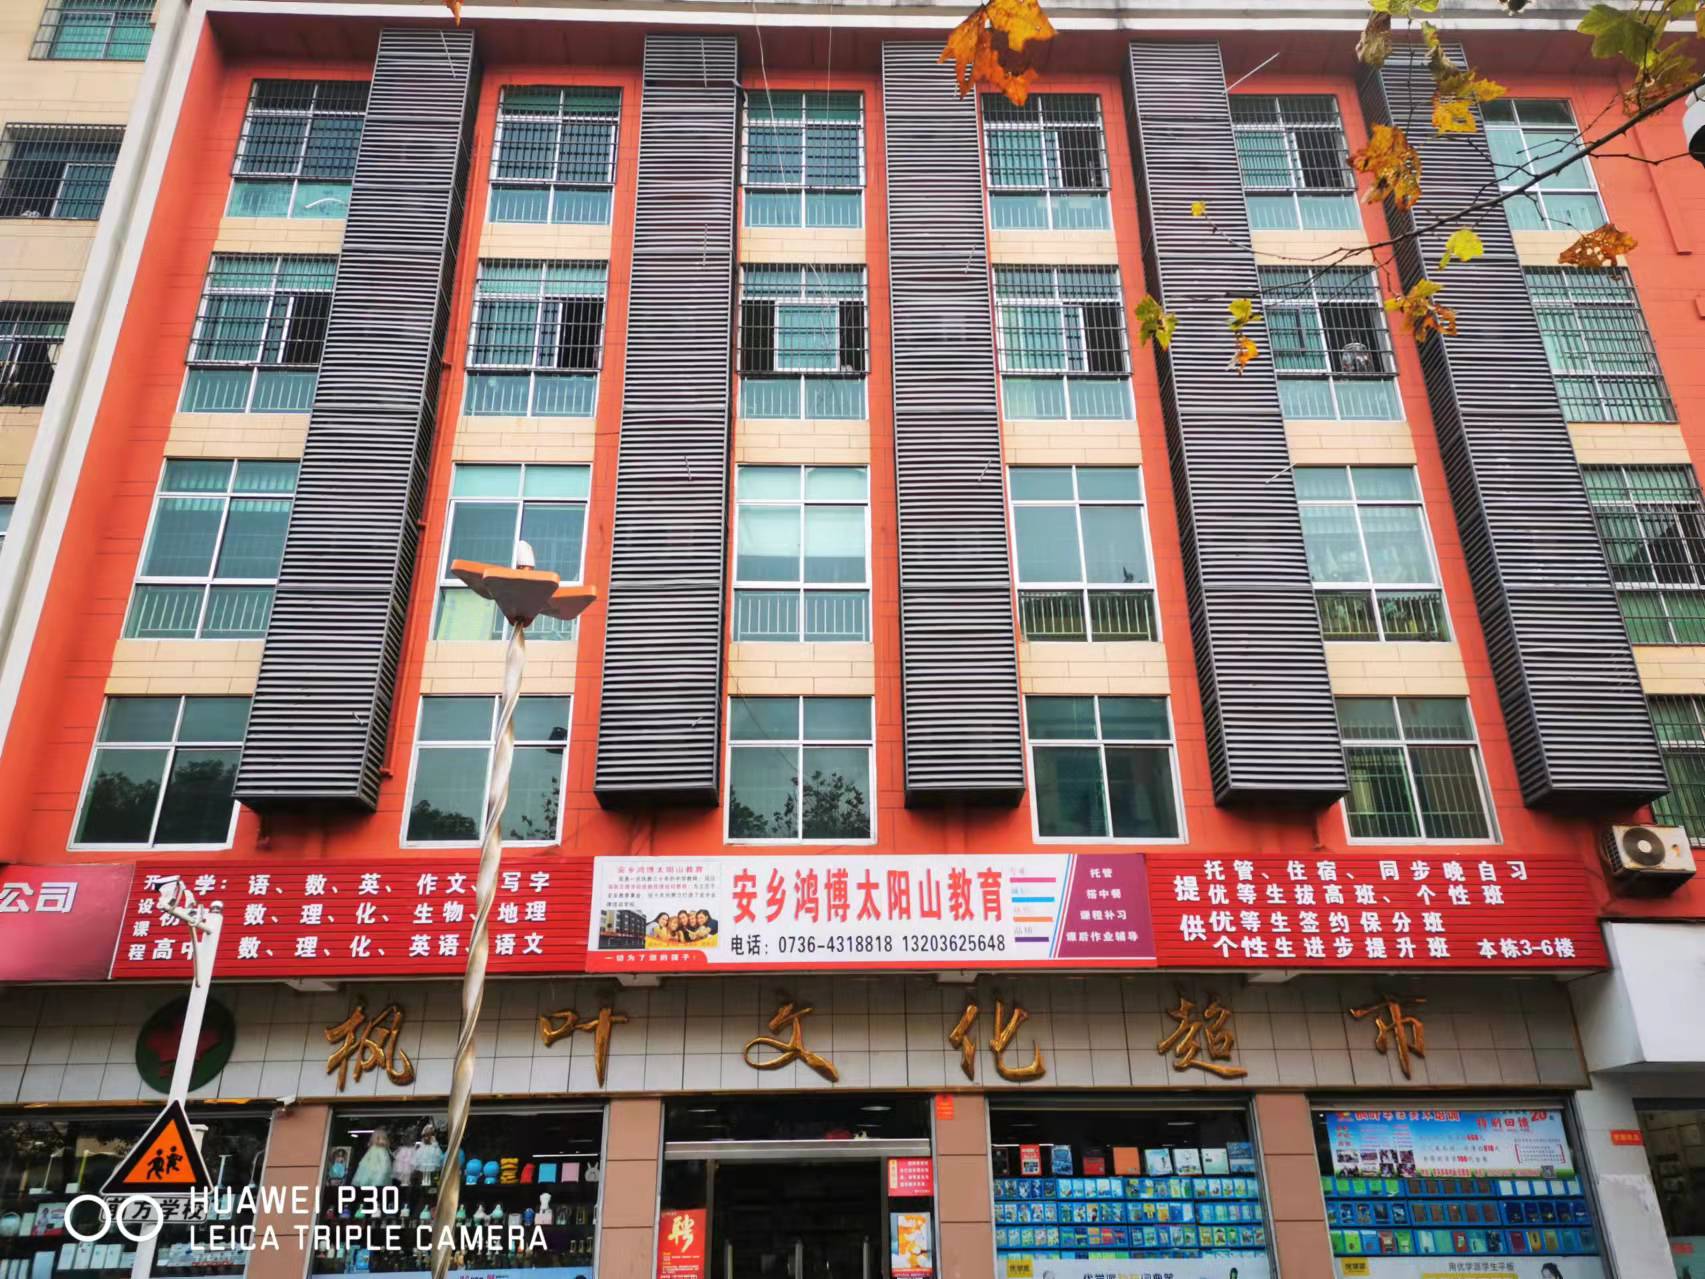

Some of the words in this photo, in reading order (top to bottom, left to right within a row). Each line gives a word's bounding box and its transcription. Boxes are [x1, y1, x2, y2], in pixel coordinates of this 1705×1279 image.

[1090, 868, 1113, 878] 托管
[0, 881, 78, 913] 公司
[732, 867, 1003, 924] 安乡鸿博太阳山教育
[1080, 910, 1127, 921] 课程补习
[1173, 876, 1208, 941] 提供
[1209, 911, 1447, 933] 优等生签约保分班
[778, 934, 893, 954] 0736-4318818
[902, 932, 1006, 953] 13203625648
[1212, 935, 1451, 959] 个性生进步提升班
[1477, 938, 1577, 960] 本栋3-6楼
[667, 1214, 695, 1253] 聘
